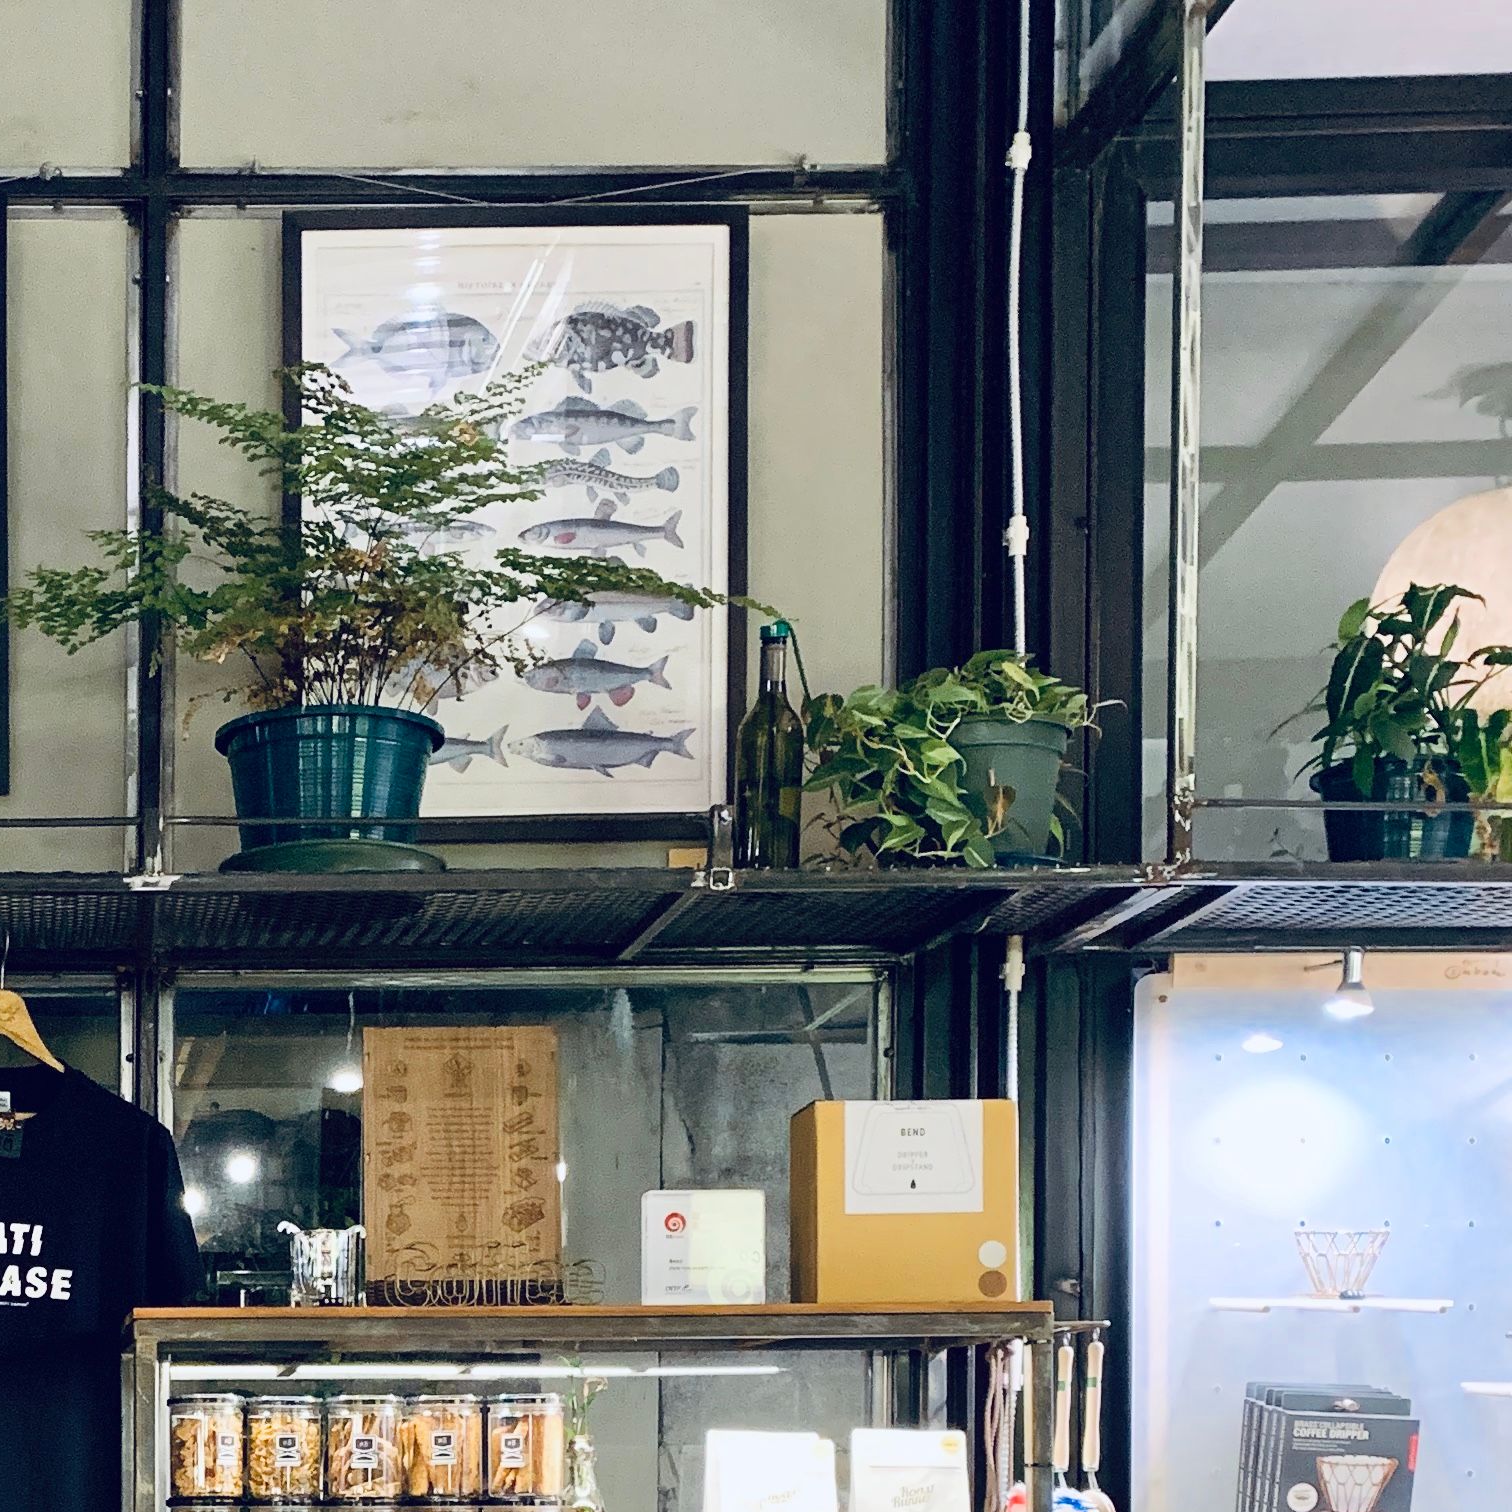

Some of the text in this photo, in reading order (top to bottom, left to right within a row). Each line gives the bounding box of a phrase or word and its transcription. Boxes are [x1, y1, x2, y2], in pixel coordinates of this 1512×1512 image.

[900, 1128, 926, 1136] BEND
[1293, 1428, 1369, 1440] COFFEE DRIPPER
